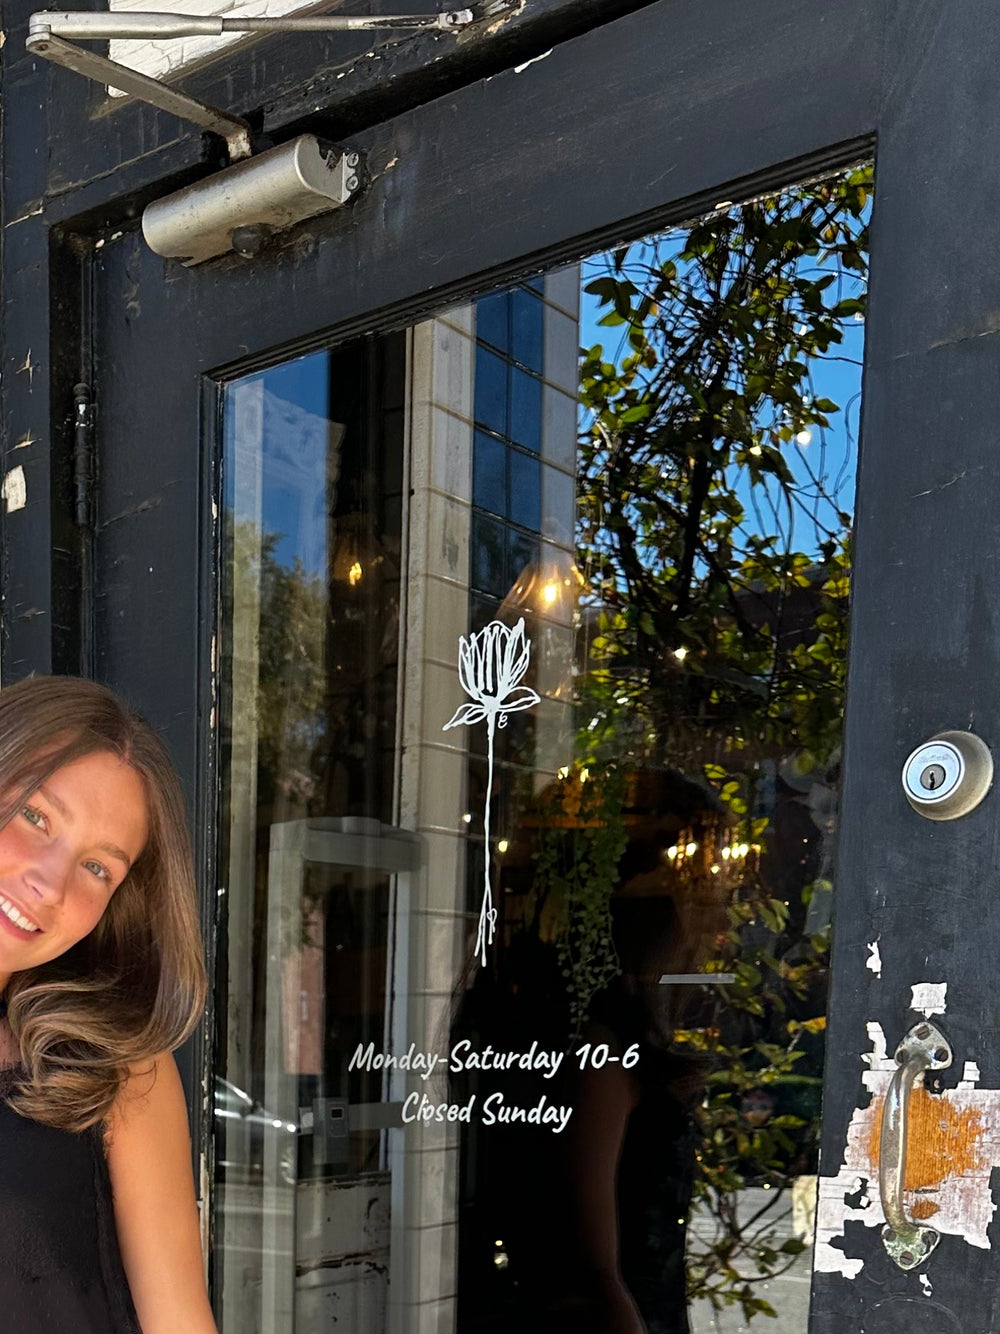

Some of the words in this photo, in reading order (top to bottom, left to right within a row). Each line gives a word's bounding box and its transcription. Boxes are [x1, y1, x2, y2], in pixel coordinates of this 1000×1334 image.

[348, 1039, 564, 1080] Monday-Saturday
[575, 1042, 640, 1070] 10-6
[401, 1091, 476, 1124] Closed
[481, 1092, 573, 1133] Sunday
